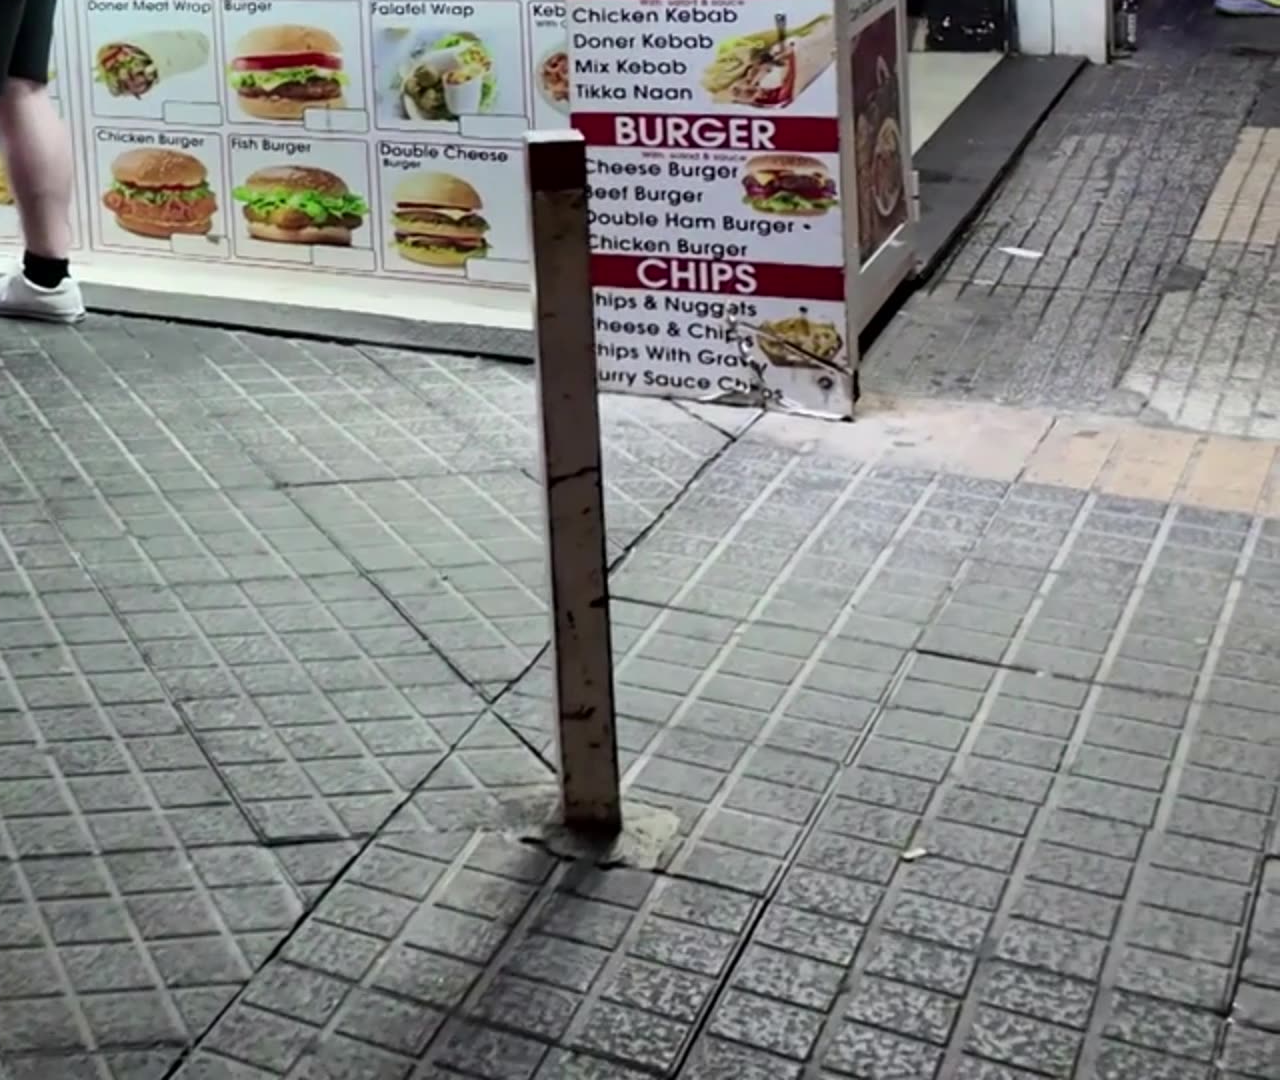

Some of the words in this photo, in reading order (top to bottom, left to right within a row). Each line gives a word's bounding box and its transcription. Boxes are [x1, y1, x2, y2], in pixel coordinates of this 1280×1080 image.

[87, 0, 130, 12] Doner
[132, 0, 170, 12] Meat
[173, 0, 212, 14] Wrap
[223, 0, 272, 15] Burger
[370, 1, 427, 16] Falafel
[429, 3, 475, 18] Wrap
[572, 7, 659, 25] Chicken
[664, 6, 739, 25] Kebab
[573, 33, 635, 50] Doner
[642, 33, 714, 50] Kebab
[574, 59, 610, 74] Mix
[616, 58, 688, 76] Kebab
[575, 84, 627, 100] Tikka
[633, 85, 693, 101] Naan
[96, 129, 157, 146] Chicken
[158, 133, 205, 150] Burger
[614, 116, 777, 150] BURGER
[230, 136, 260, 151] Fish
[264, 138, 313, 155] Burger
[380, 142, 439, 161] Double
[443, 145, 509, 163] Cheese
[382, 158, 422, 171] Burger
[585, 158, 662, 177] Cheese
[668, 161, 739, 182] Burger
[634, 186, 704, 207] Burger
[587, 209, 659, 228] Double
[665, 212, 716, 230] Ham
[723, 216, 795, 237] Burger
[588, 234, 671, 254] Chicken
[677, 236, 748, 260] Burger
[636, 257, 759, 294] CHIPS
[594, 292, 638, 311] hips
[642, 294, 658, 311] &
[596, 317, 661, 336] heese
[666, 321, 681, 338] &
[597, 343, 640, 361] hips
[645, 345, 691, 363] With
[598, 370, 639, 387] urry
[643, 370, 712, 391] Sauce
